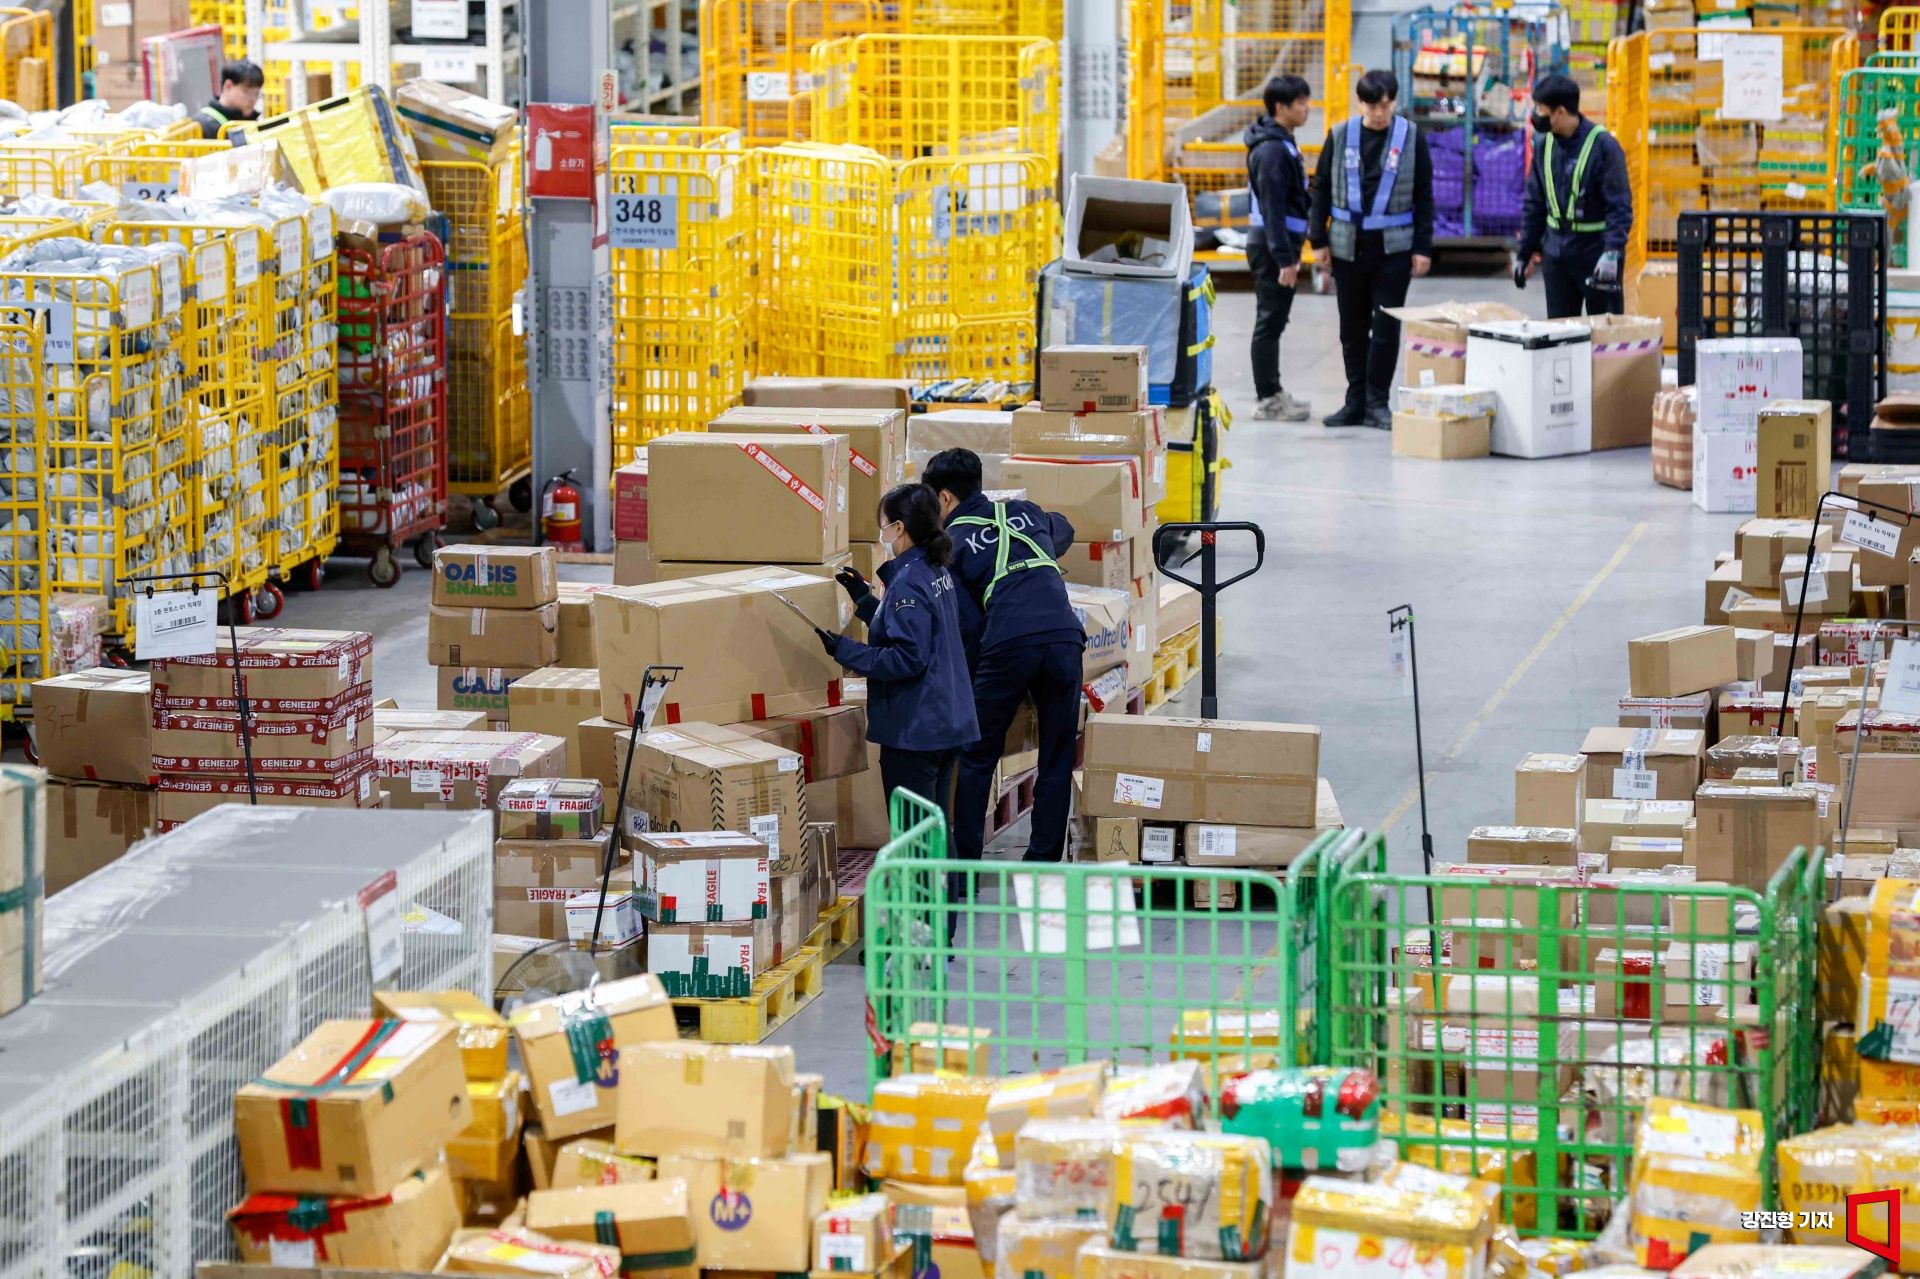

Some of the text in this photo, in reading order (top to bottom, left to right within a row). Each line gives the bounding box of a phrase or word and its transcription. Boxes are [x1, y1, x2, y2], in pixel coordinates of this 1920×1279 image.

[603, 73, 614, 100] 소화기
[560, 158, 585, 169] 소화기
[616, 200, 661, 223] 348
[965, 512, 1035, 555] KCDI
[445, 563, 518, 584] OASIS
[445, 582, 518, 598] SNACKS
[239, 658, 281, 668] GENIEZIP
[302, 656, 339, 666] ENIEZIP
[278, 700, 321, 709] GENIEZIP
[45, 706, 76, 740] 3F
[193, 721, 235, 732] GENIEZIP
[257, 725, 297, 734] GENIEZIP
[198, 759, 239, 768] GENIEZIP
[261, 759, 302, 768] GENIEZIP
[296, 788, 337, 798] GENIEZIP
[509, 800, 532, 810] FRAG
[530, 889, 566, 900] FRAGILE
[713, 1201, 750, 1223] M+
